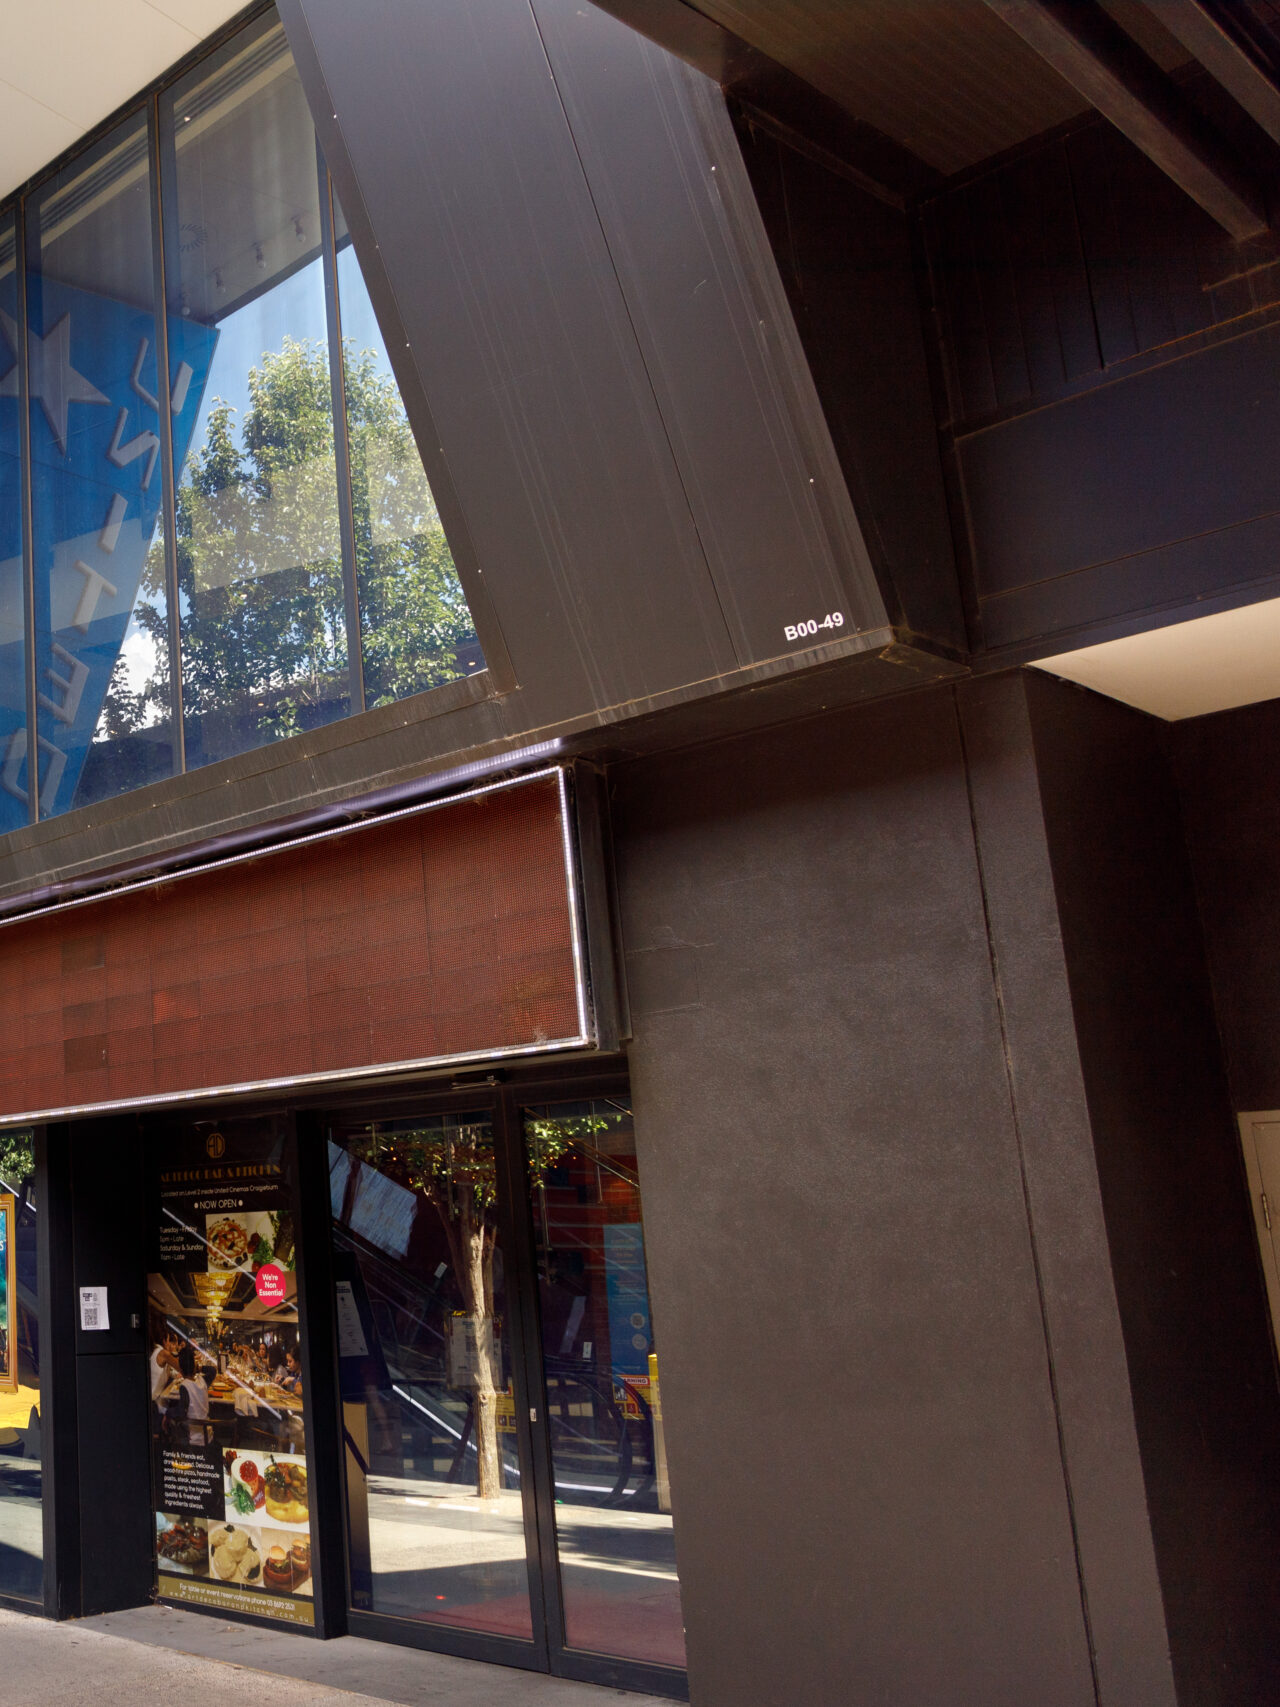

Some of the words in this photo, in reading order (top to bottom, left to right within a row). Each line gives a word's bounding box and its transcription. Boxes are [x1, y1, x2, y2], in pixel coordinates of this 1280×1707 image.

[784, 612, 844, 641] B00-49
[200, 1200, 217, 1210] NOW
[219, 1199, 237, 1208] OPEN
[261, 1273, 278, 1281] We're
[258, 1288, 283, 1296] Essential
